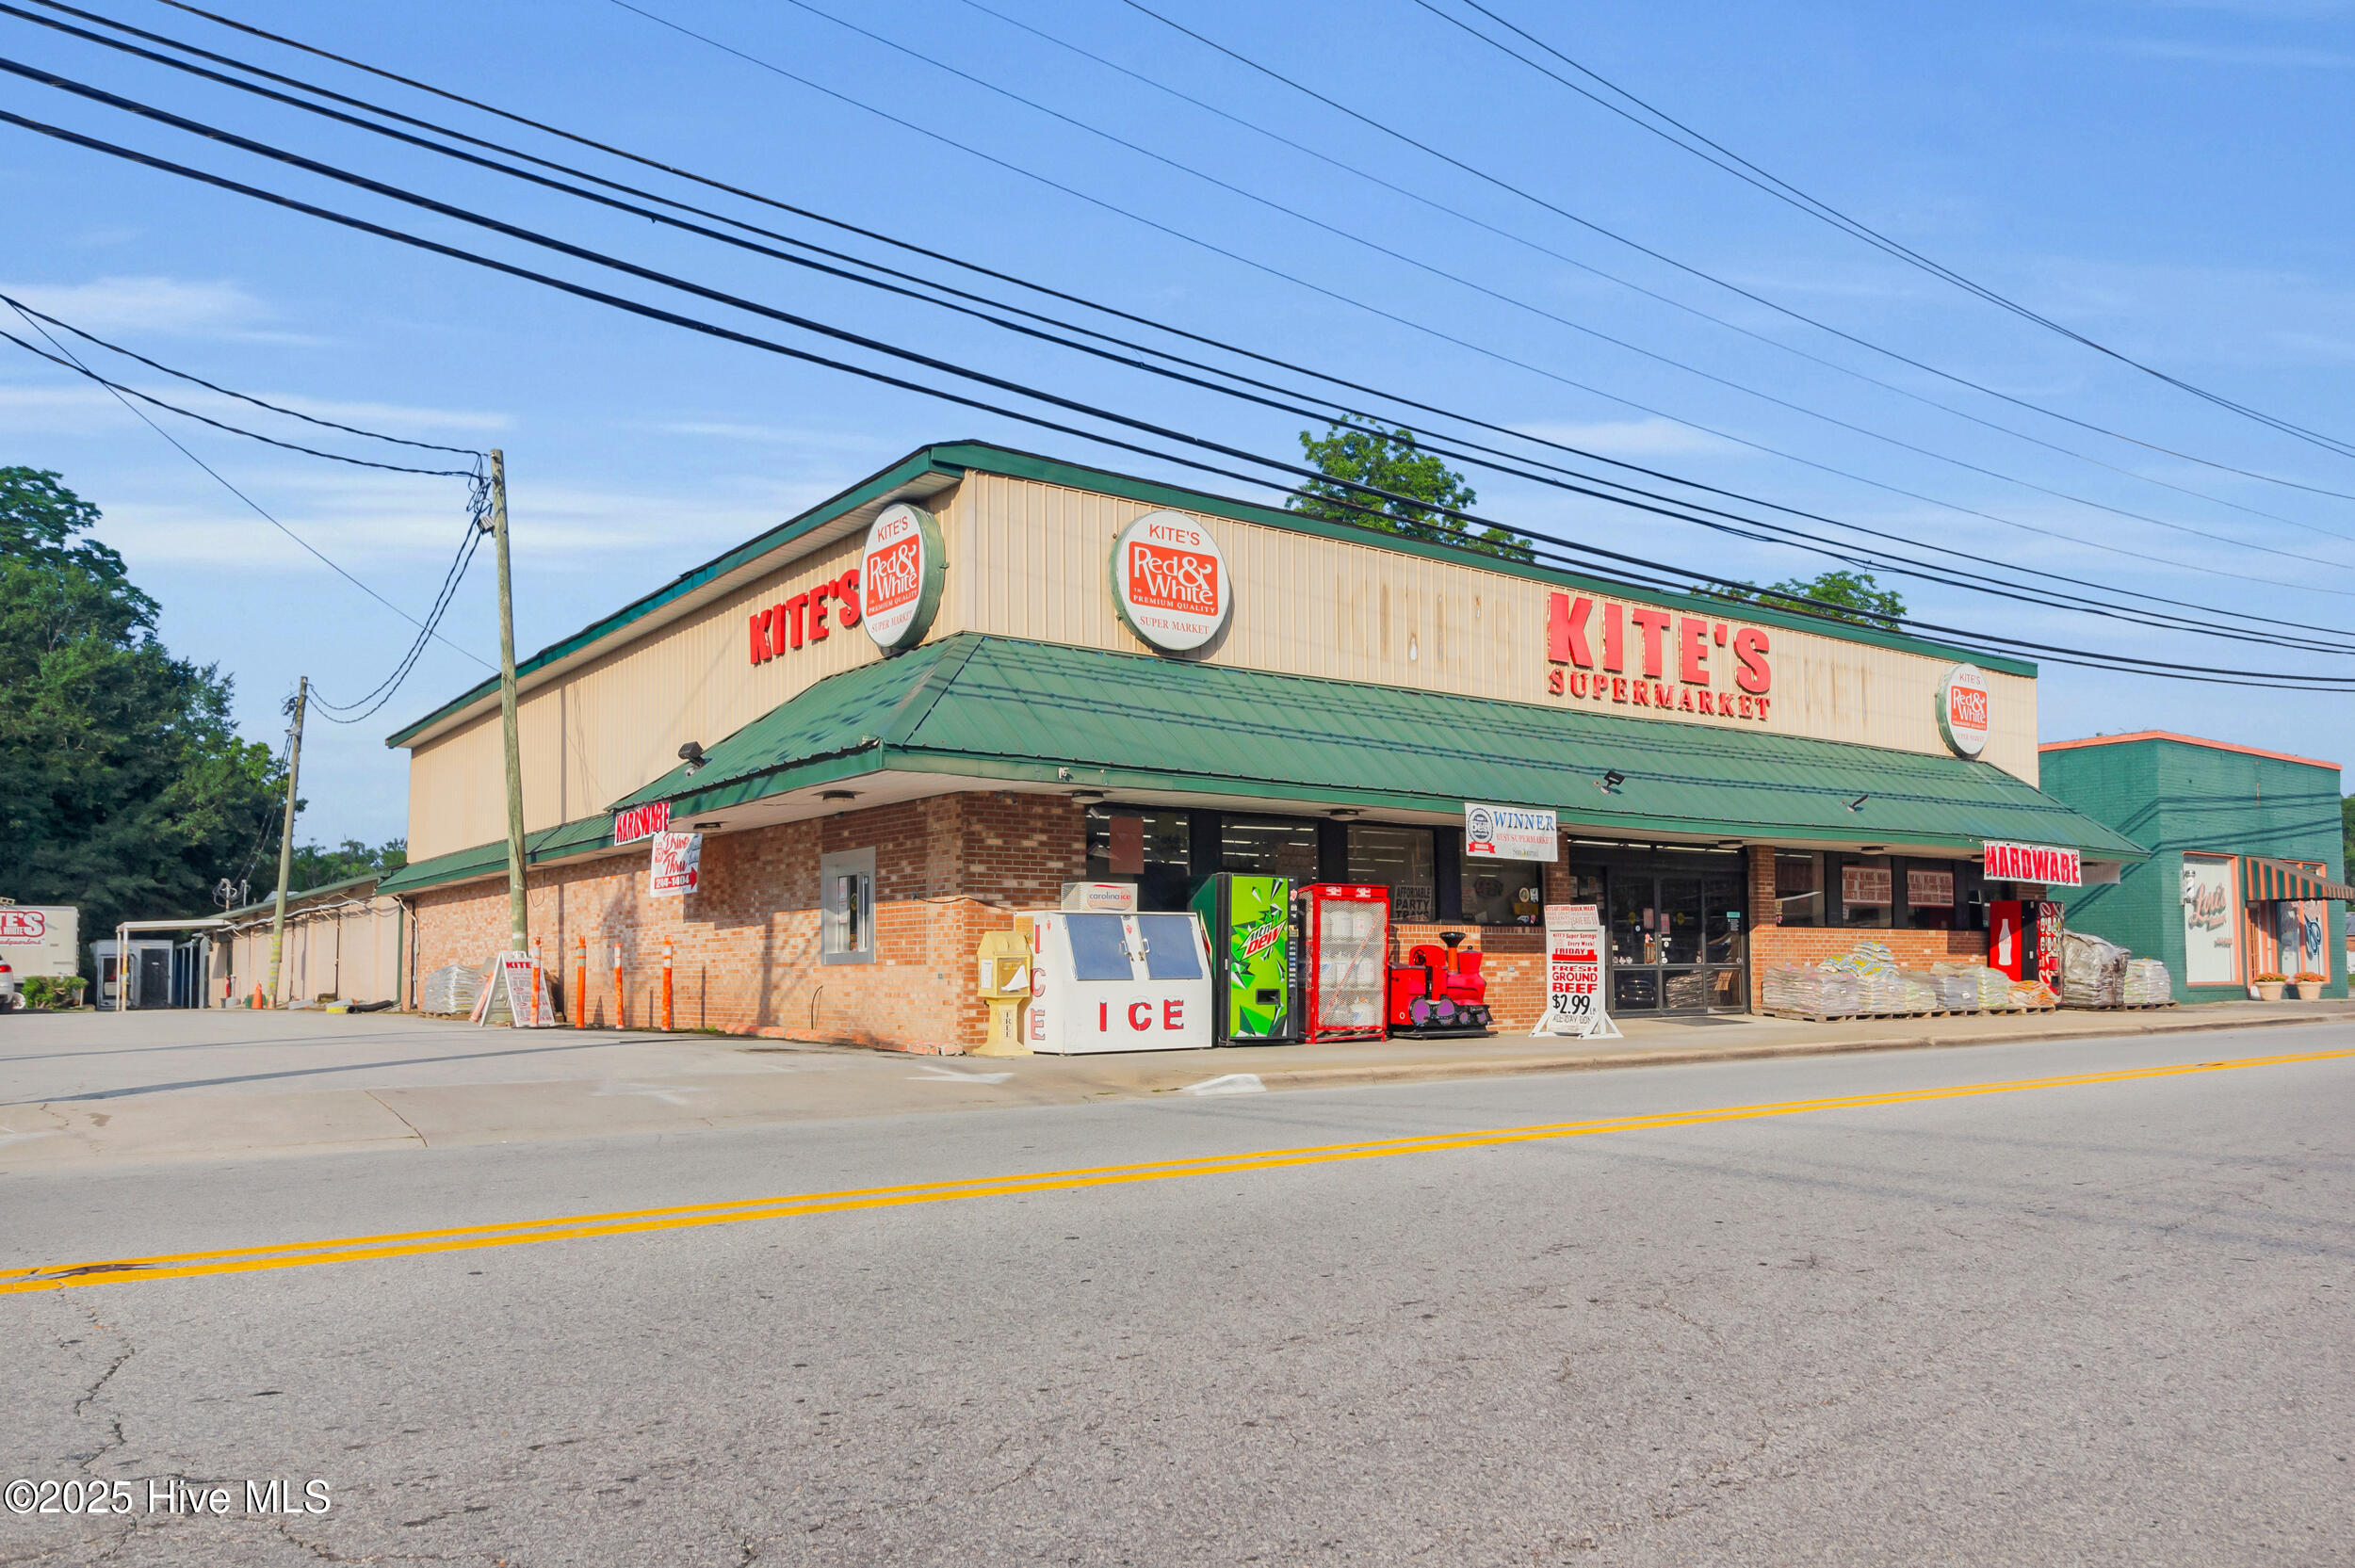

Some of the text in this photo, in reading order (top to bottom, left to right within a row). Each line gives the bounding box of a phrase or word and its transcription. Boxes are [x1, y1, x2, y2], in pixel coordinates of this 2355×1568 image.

[877, 515, 908, 542] KITE'S
[1149, 524, 1200, 545] KITE'S
[876, 572, 918, 601] White
[1149, 574, 1213, 605] White
[869, 590, 918, 614] PREMIUM QUALITY
[1133, 594, 1215, 614] PREMIUM QUALITY
[749, 568, 861, 666] KITE'S
[870, 609, 913, 633] SUPER MARKET
[1140, 615, 1210, 635] SUPER MARKET
[1548, 591, 1771, 694] KITE'S
[1959, 672, 1981, 686] KITE'S
[1548, 668, 1771, 720] SUPERMARKET
[1959, 705, 1986, 724] White
[616, 801, 670, 843] HARDWARE
[1493, 811, 1555, 831] WINNER
[663, 832, 690, 854] Drive
[1496, 833, 1553, 845] BEST SUPERMARKET
[663, 851, 687, 875] Thru
[1985, 845, 2080, 883] HARDWARE
[1397, 886, 1431, 898] AFFORDABLE
[1396, 898, 1430, 910] PARTY
[1552, 972, 1598, 982] GROUND
[1552, 982, 1598, 994] BEEF
[1099, 999, 1184, 1031] ICE
[1552, 994, 1590, 1015] $2.99
[1564, 1014, 1577, 1024] DAY
[1580, 1015, 1593, 1025] LON
